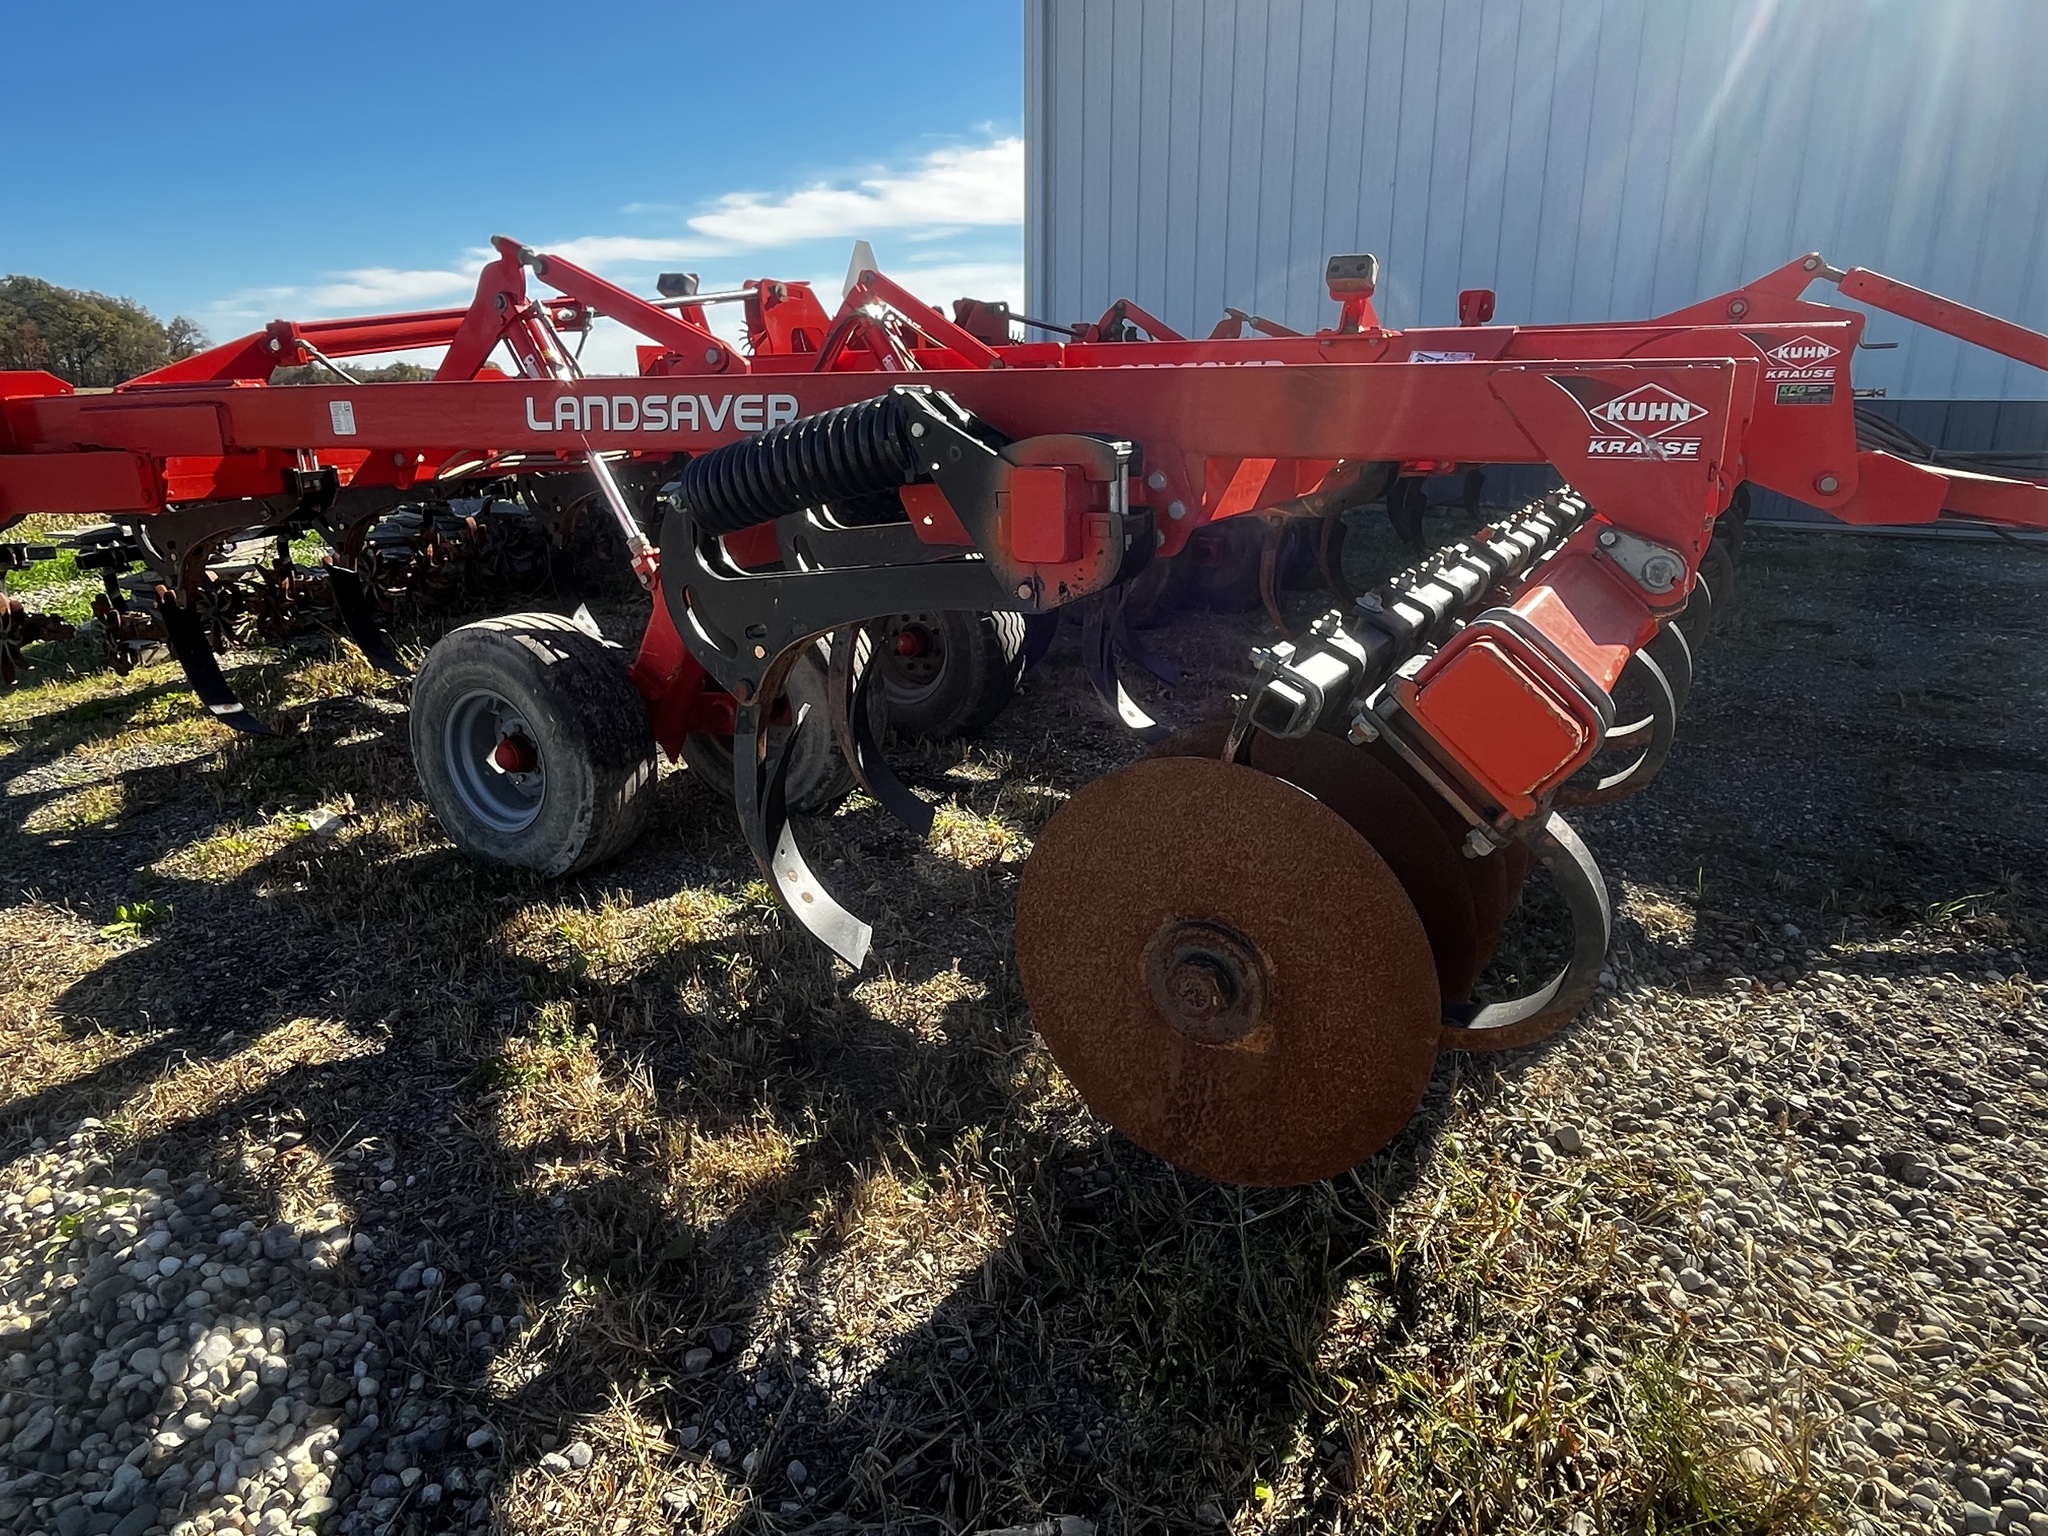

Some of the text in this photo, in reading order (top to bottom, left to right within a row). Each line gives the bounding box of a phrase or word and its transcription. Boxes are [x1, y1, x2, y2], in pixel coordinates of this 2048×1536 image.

[1778, 346, 1830, 359] KUHN
[1765, 369, 1836, 379] KRAUSE
[526, 394, 799, 432] LANDSAVER
[1607, 402, 1690, 421] KUHN
[1588, 440, 1700, 455] KRASE
